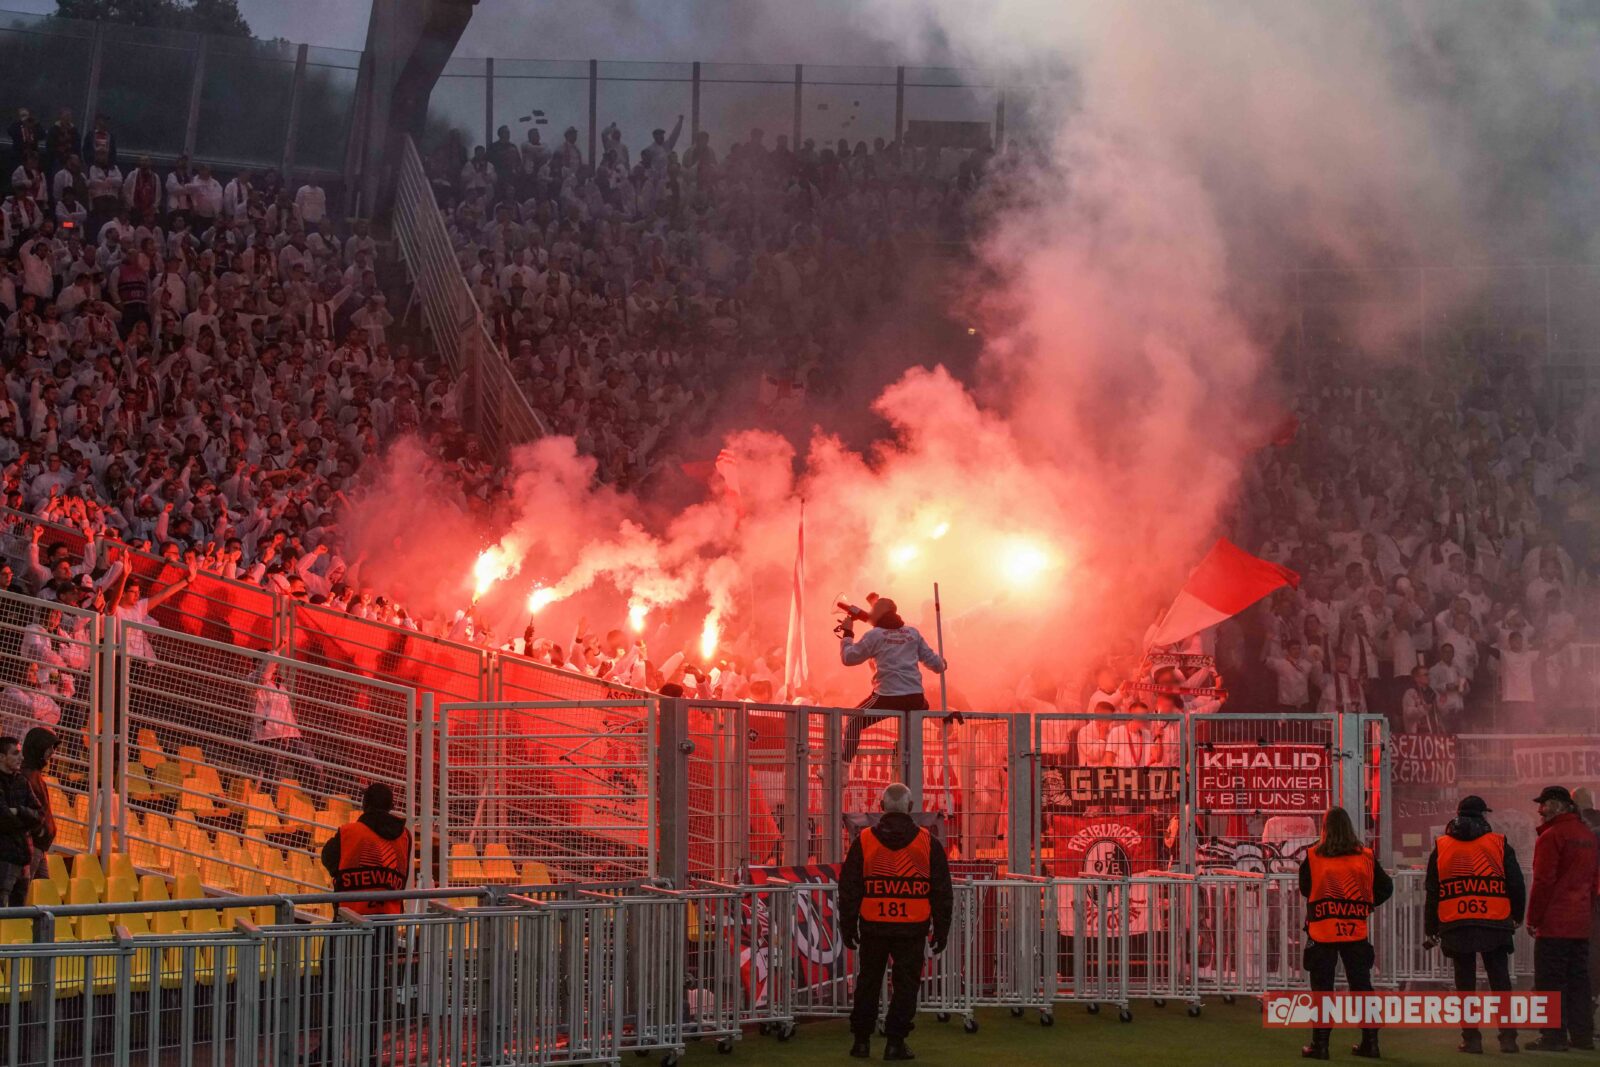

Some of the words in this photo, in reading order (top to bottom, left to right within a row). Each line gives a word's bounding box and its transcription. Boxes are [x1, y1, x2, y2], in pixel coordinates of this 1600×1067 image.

[1389, 734, 1456, 760] SEZIONE
[1203, 752, 1321, 770] KHALID
[1203, 773, 1245, 788] FÜR
[1252, 776, 1323, 789] IMMER
[1220, 793, 1251, 805] BEI
[1259, 793, 1306, 805] UNS
[1067, 823, 1142, 852] FREIBURGER
[864, 880, 930, 895] TEWARD
[878, 902, 908, 917] 181
[1457, 900, 1488, 914] 063
